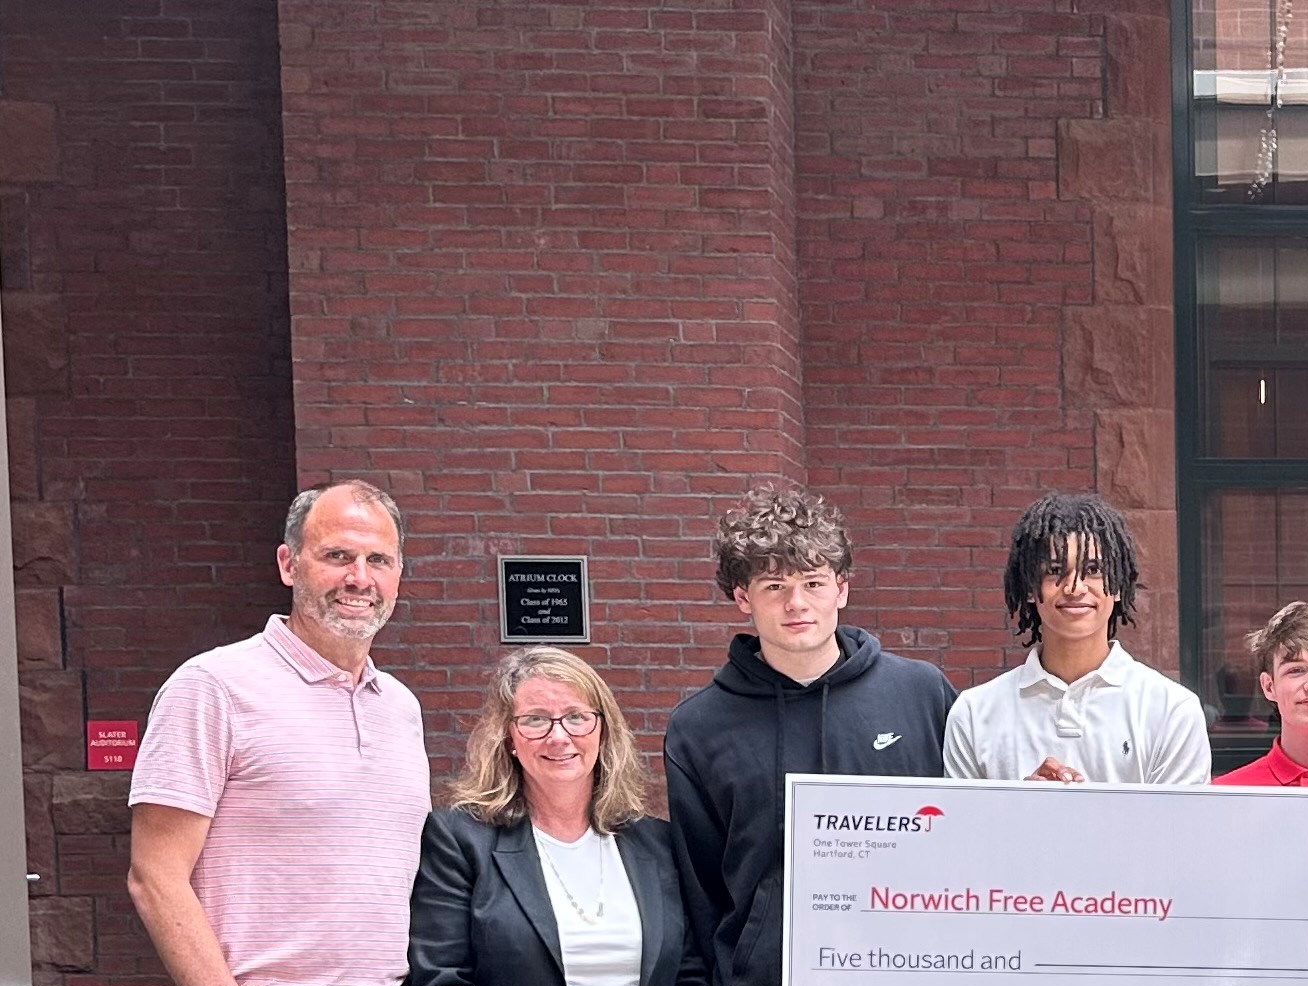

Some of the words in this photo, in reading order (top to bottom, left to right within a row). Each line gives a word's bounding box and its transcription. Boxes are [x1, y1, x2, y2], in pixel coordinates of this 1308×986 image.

[508, 574, 545, 582] ATRIUM
[546, 574, 578, 582] CLOCK
[520, 598, 540, 606] Class
[541, 598, 550, 606] of
[521, 616, 541, 624] Class
[542, 616, 550, 624] of
[98, 731, 127, 739] SLATER
[813, 814, 922, 832] TRAVELERS
[813, 838, 833, 848] One
[835, 839, 862, 849] Tower
[864, 840, 897, 850] Square
[813, 849, 856, 859] Hartford,
[858, 850, 871, 859] CT
[812, 893, 828, 902] PAY
[829, 894, 841, 902] TO
[842, 894, 857, 902] THE
[812, 903, 840, 911] ORDER
[841, 903, 853, 911] OF
[870, 886, 980, 911] Norwich
[988, 889, 1044, 913] Free
[1050, 891, 1172, 921] Academy
[819, 947, 862, 969] Five
[867, 948, 974, 971] thousand
[980, 950, 1022, 971] and
